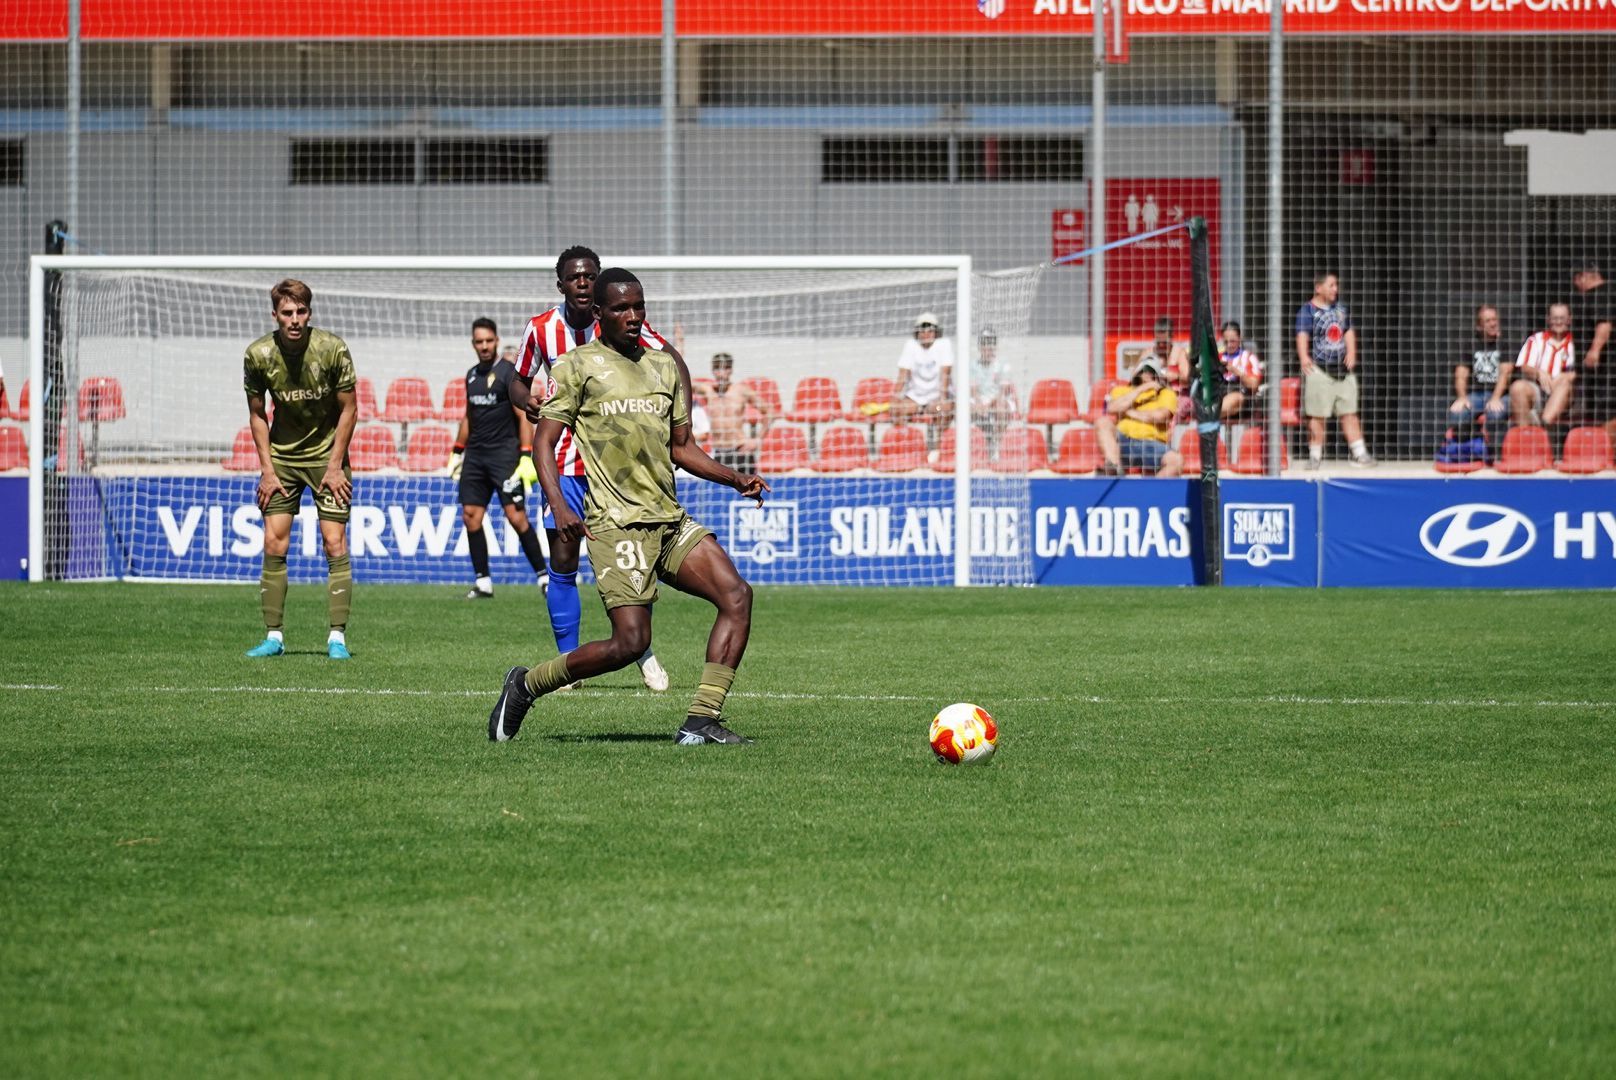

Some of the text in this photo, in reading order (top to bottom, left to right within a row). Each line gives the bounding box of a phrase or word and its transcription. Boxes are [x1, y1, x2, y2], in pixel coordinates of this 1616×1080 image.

[830, 506, 1191, 558] SOLAN DE CABRAS
[1233, 510, 1284, 532] SOLAN
[615, 540, 649, 570] 31
